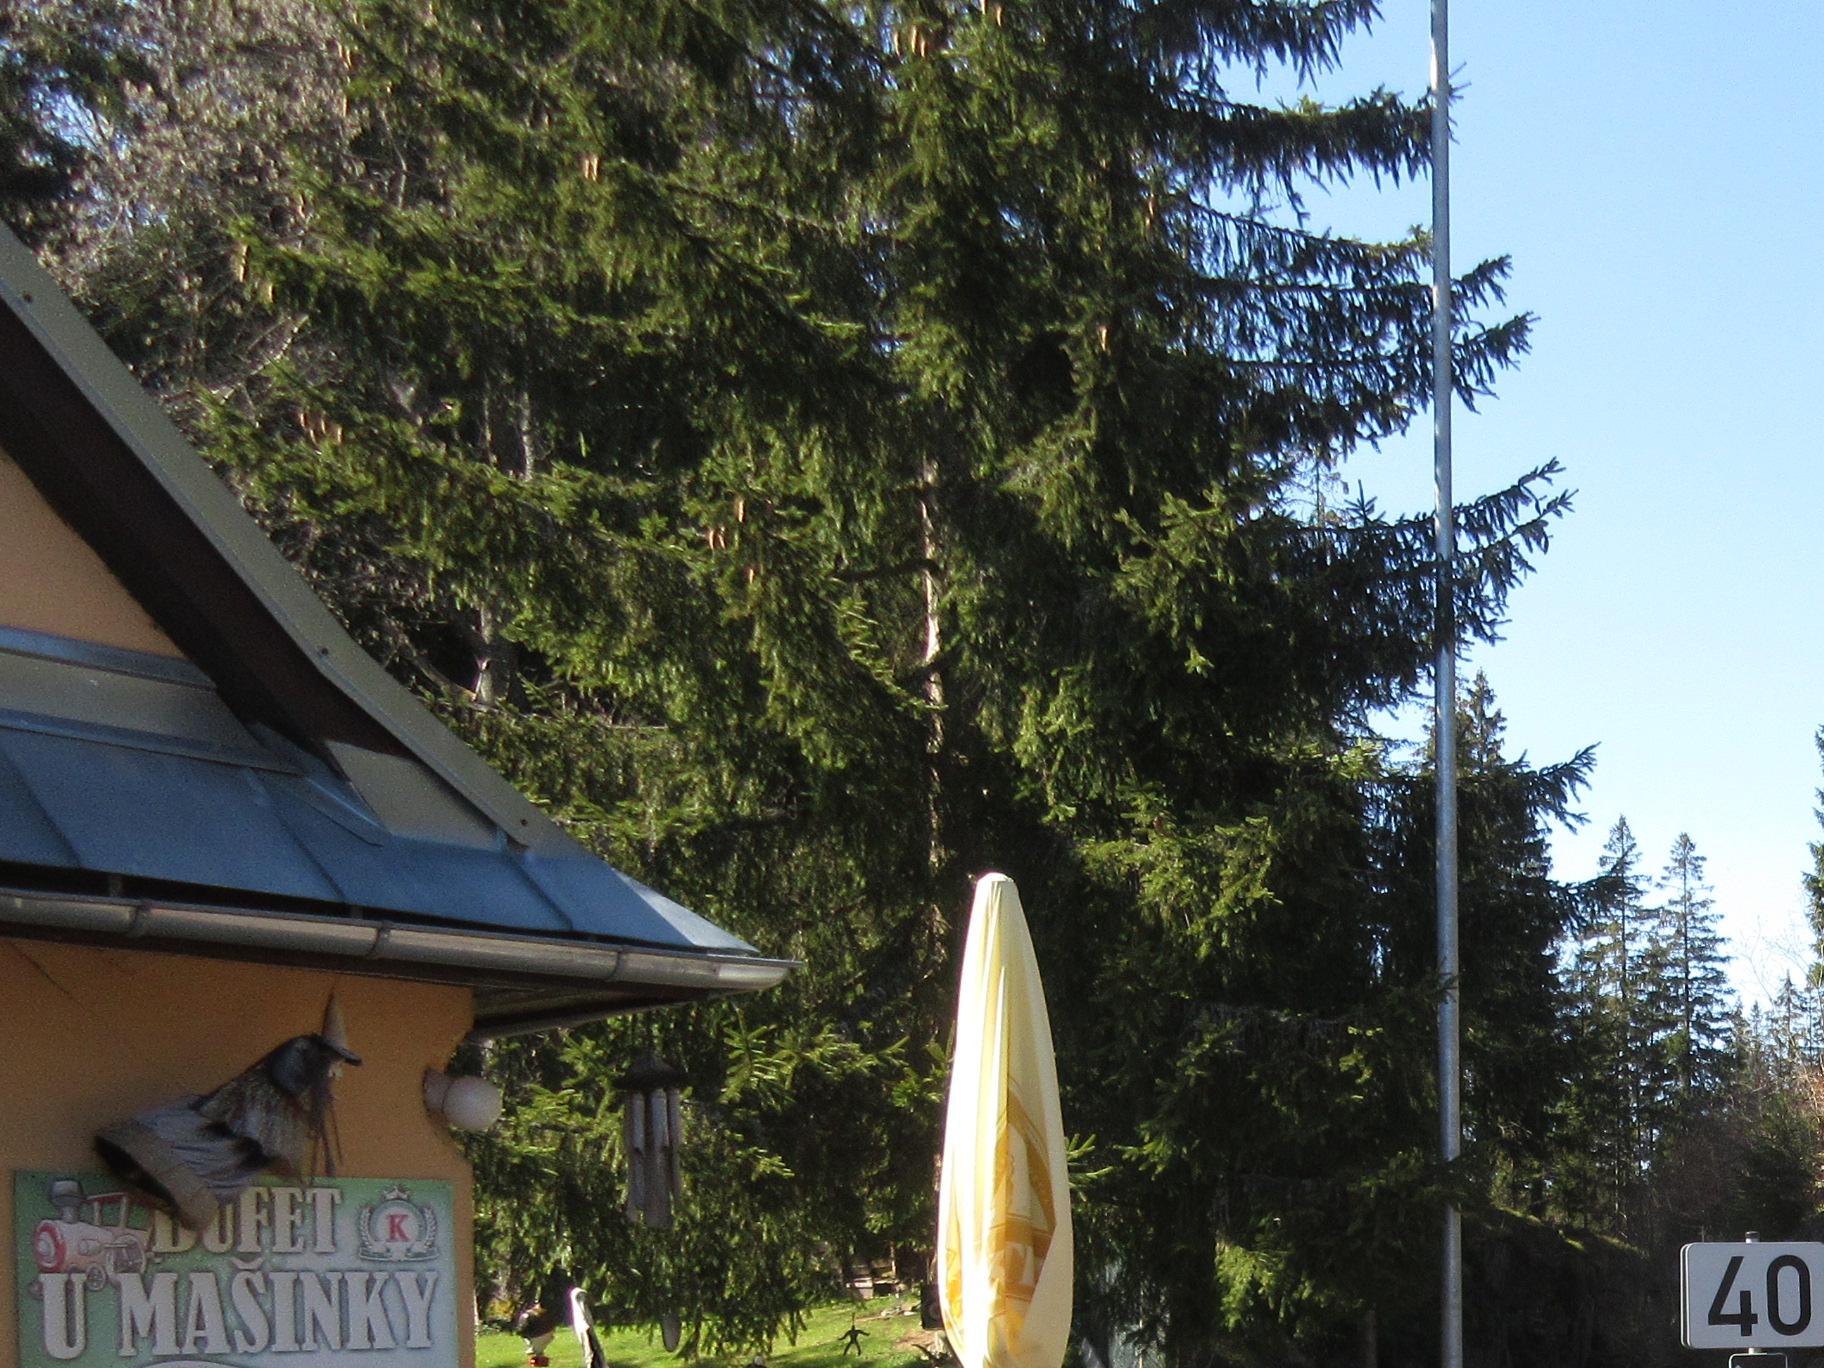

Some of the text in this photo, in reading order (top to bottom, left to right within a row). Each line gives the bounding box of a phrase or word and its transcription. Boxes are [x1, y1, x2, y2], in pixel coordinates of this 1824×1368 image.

[386, 1214, 409, 1244] K
[40, 1258, 438, 1360] U MAŠINKY
[1708, 1255, 1811, 1337] 40
